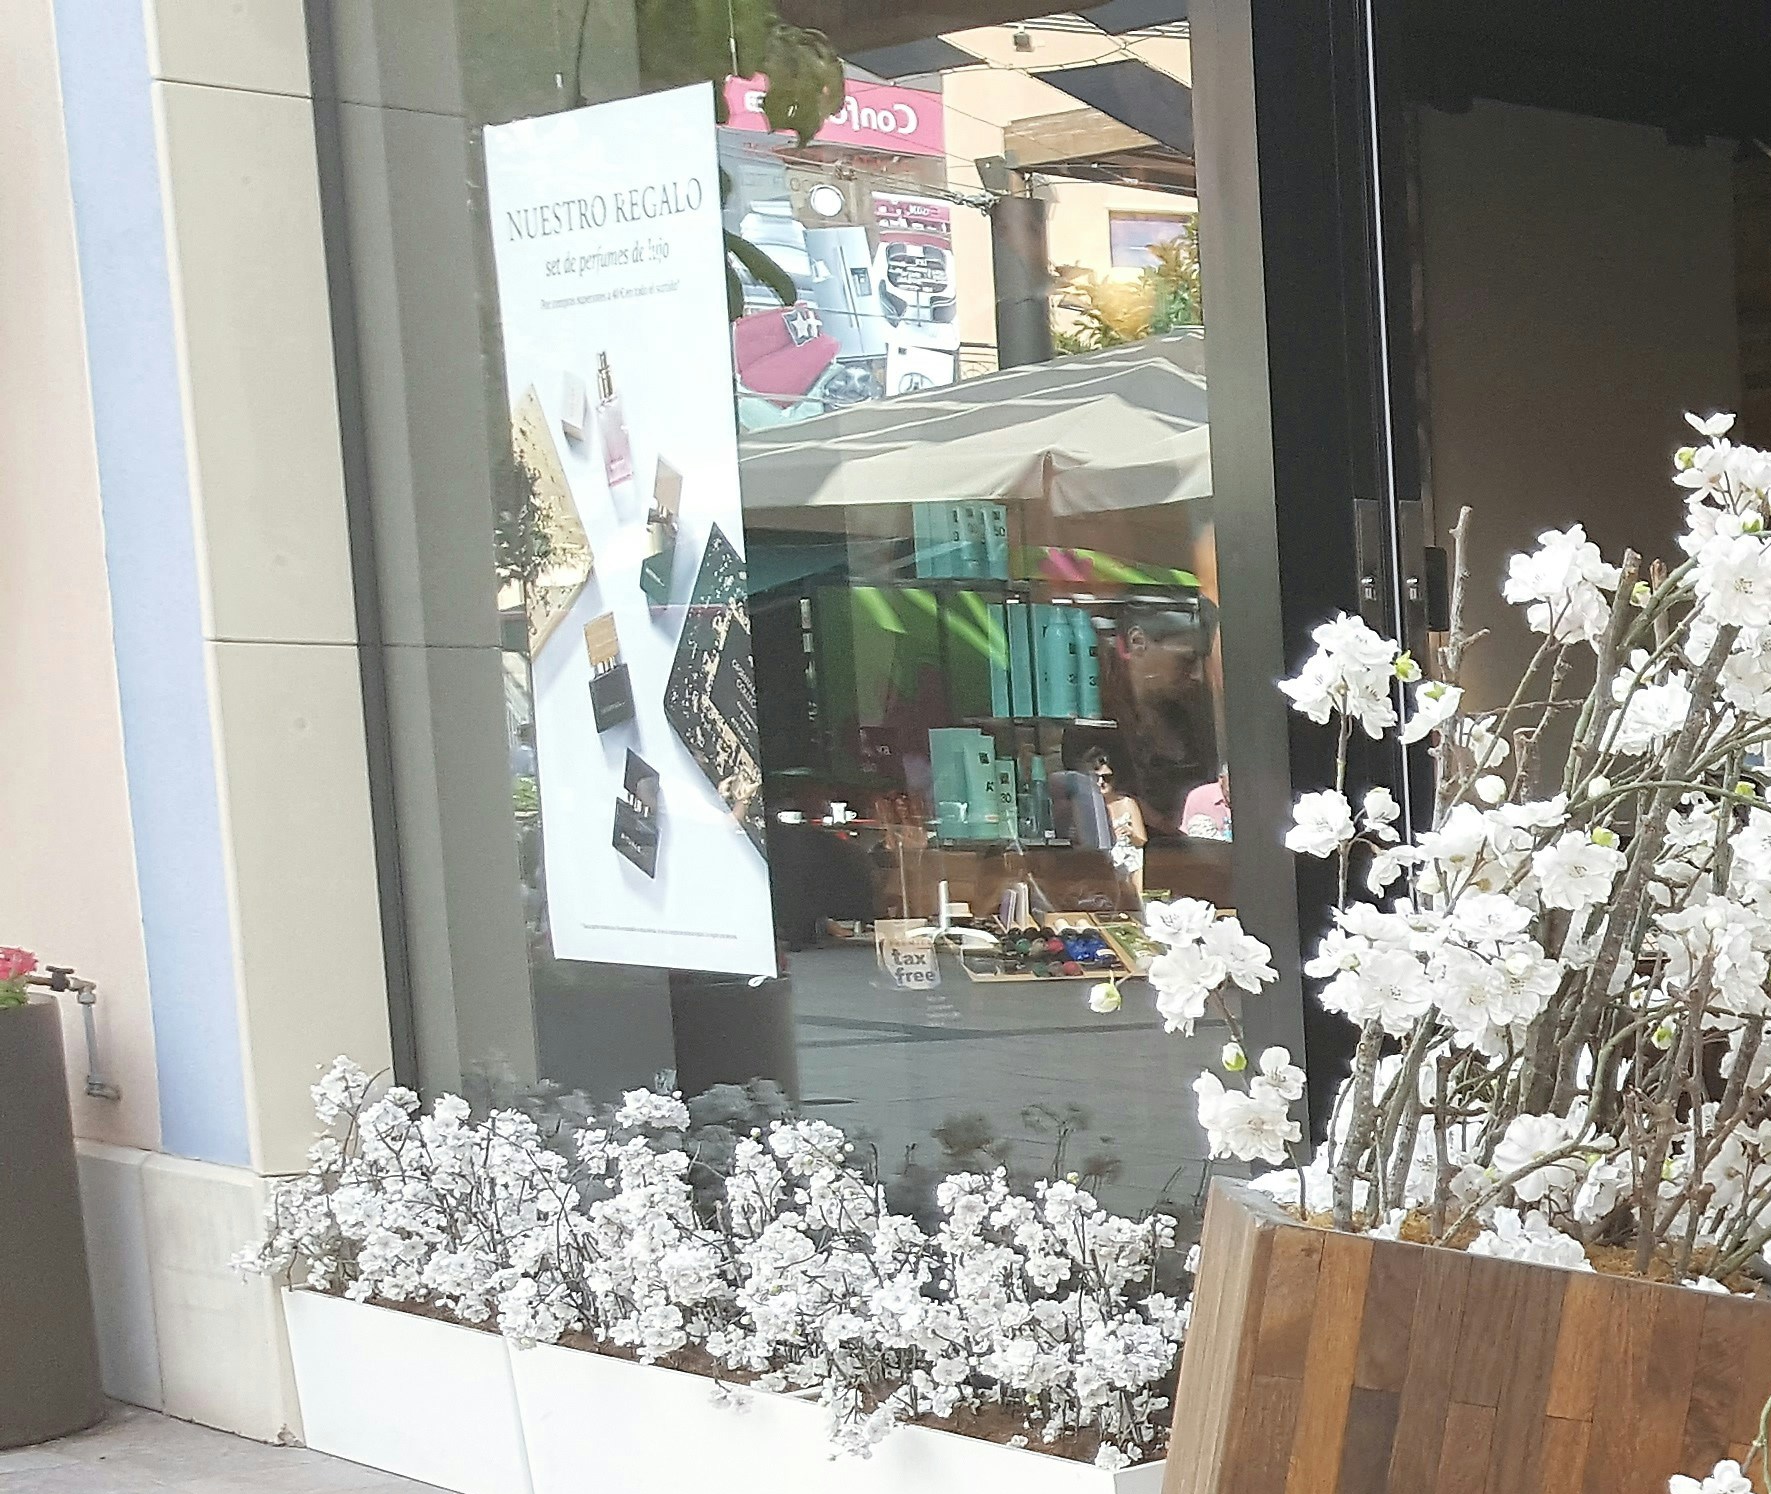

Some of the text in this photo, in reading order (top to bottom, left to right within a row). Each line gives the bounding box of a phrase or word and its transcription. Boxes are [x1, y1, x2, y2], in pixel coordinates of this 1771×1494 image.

[507, 177, 703, 242] NUESTRO REGALO
[545, 257, 561, 277] set
[563, 251, 577, 274] de
[579, 246, 629, 277] perfumes
[632, 240, 644, 263] de
[891, 947, 927, 966] tax
[895, 967, 935, 985] free
